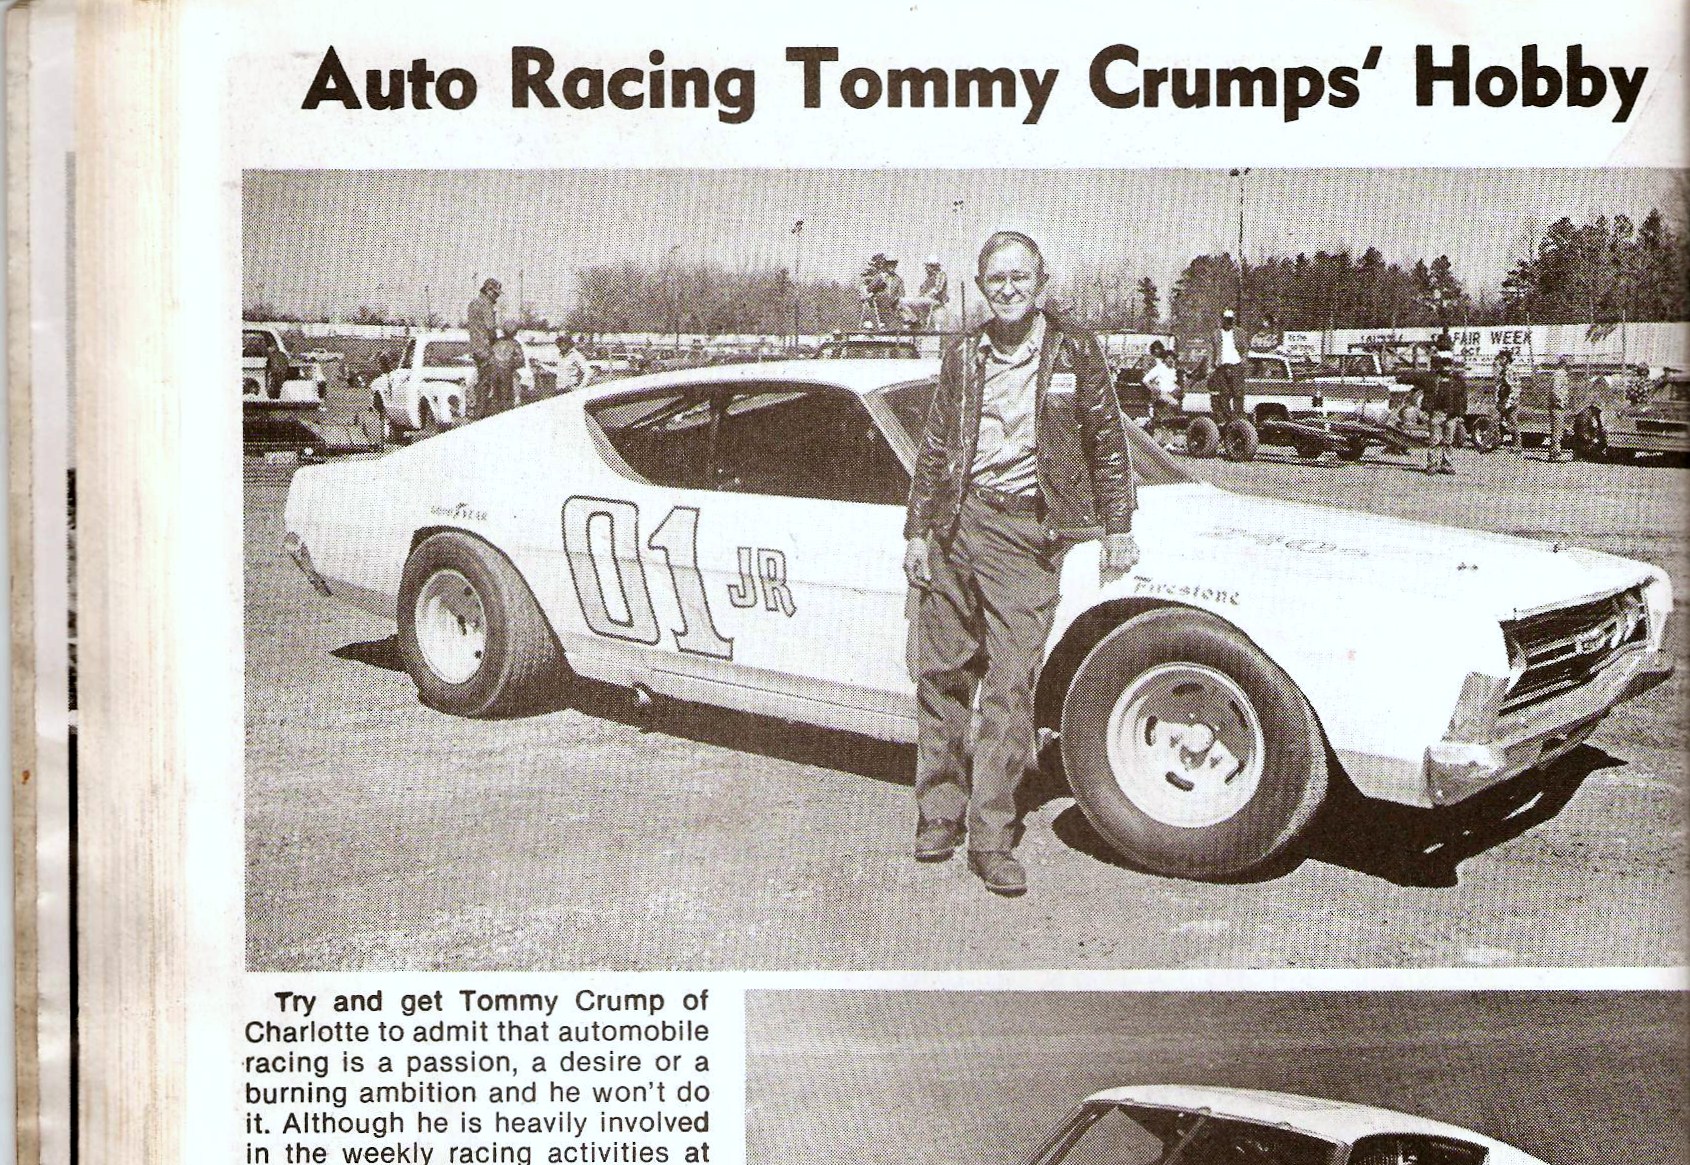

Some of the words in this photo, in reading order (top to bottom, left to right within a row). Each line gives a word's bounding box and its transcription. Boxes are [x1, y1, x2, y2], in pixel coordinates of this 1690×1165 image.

[301, 46, 477, 110] Auto
[512, 46, 754, 124] Racing
[786, 47, 1059, 124] Tommy
[1416, 44, 1648, 122] Hobby
[1454, 331, 1480, 345] FAIR
[1490, 330, 1532, 345] WEEK
[562, 495, 734, 661] 01
[728, 546, 798, 618] JR
[274, 991, 316, 1017] Try
[334, 990, 382, 1012] and
[401, 991, 442, 1016] get
[459, 990, 558, 1016] Tommy
[576, 990, 664, 1015] Crump
[683, 989, 708, 1010] of
[245, 1021, 369, 1043] Charlotte
[379, 1022, 404, 1041] to
[413, 1021, 488, 1042] admit
[497, 1020, 548, 1042] that
[559, 1020, 708, 1042] automobile
